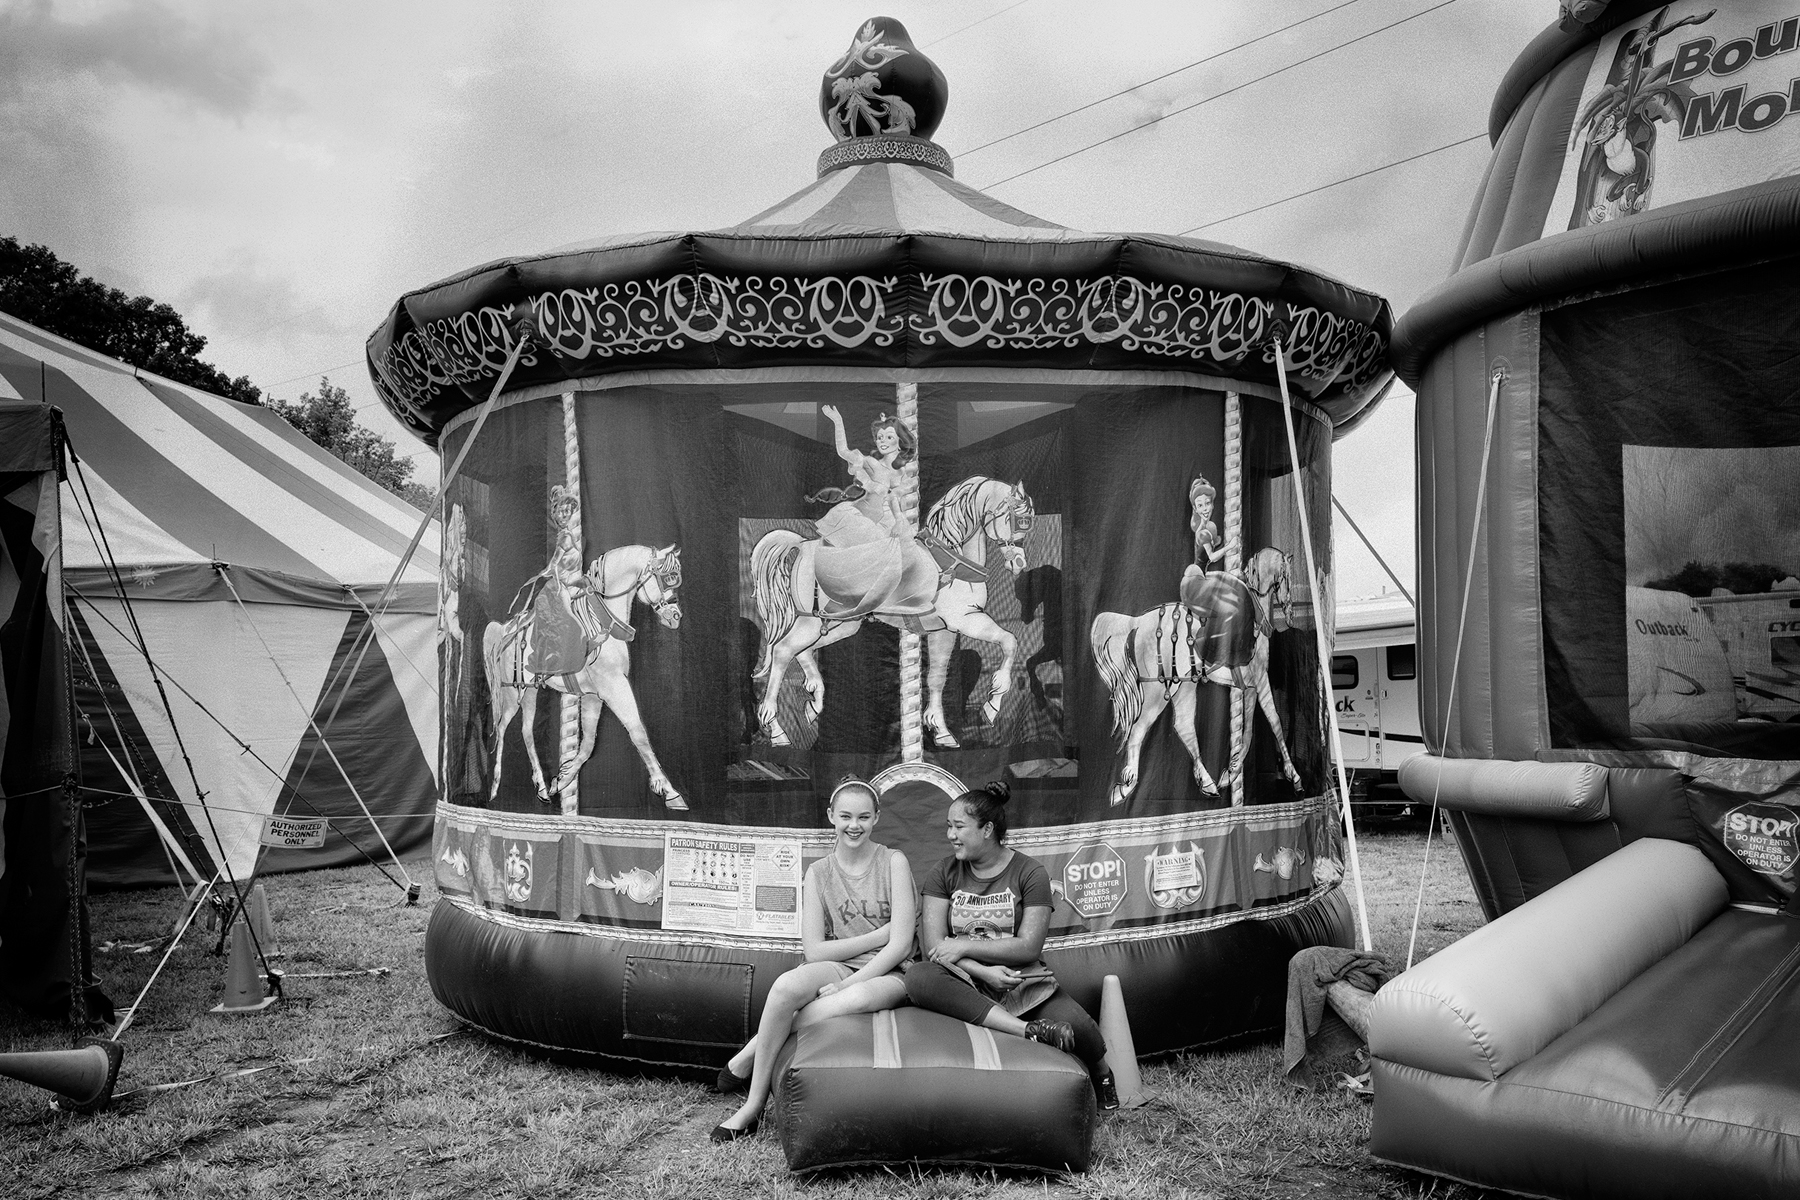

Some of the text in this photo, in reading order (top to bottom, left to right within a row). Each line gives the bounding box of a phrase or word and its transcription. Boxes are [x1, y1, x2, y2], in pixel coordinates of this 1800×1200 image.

[1635, 618, 1689, 636] Outback
[270, 820, 322, 831] AUTHORIZED
[270, 828, 320, 838] PERSONNEL
[671, 838, 695, 847] PATRON
[695, 840, 718, 849] SAFETY
[719, 842, 738, 851] RULES
[1750, 836, 1768, 844] NOT
[1749, 844, 1782, 854] UNLESS
[1737, 850, 1782, 861] OPERATOR
[1068, 860, 1121, 882] STOP!
[671, 881, 716, 889] OWNER/OPERATOR
[1084, 888, 1110, 896] UNLESS
[955, 893, 1012, 906] 30 ANNIVERSARY
[1076, 896, 1110, 905] OPERATOR
[838, 898, 891, 925] KLE
